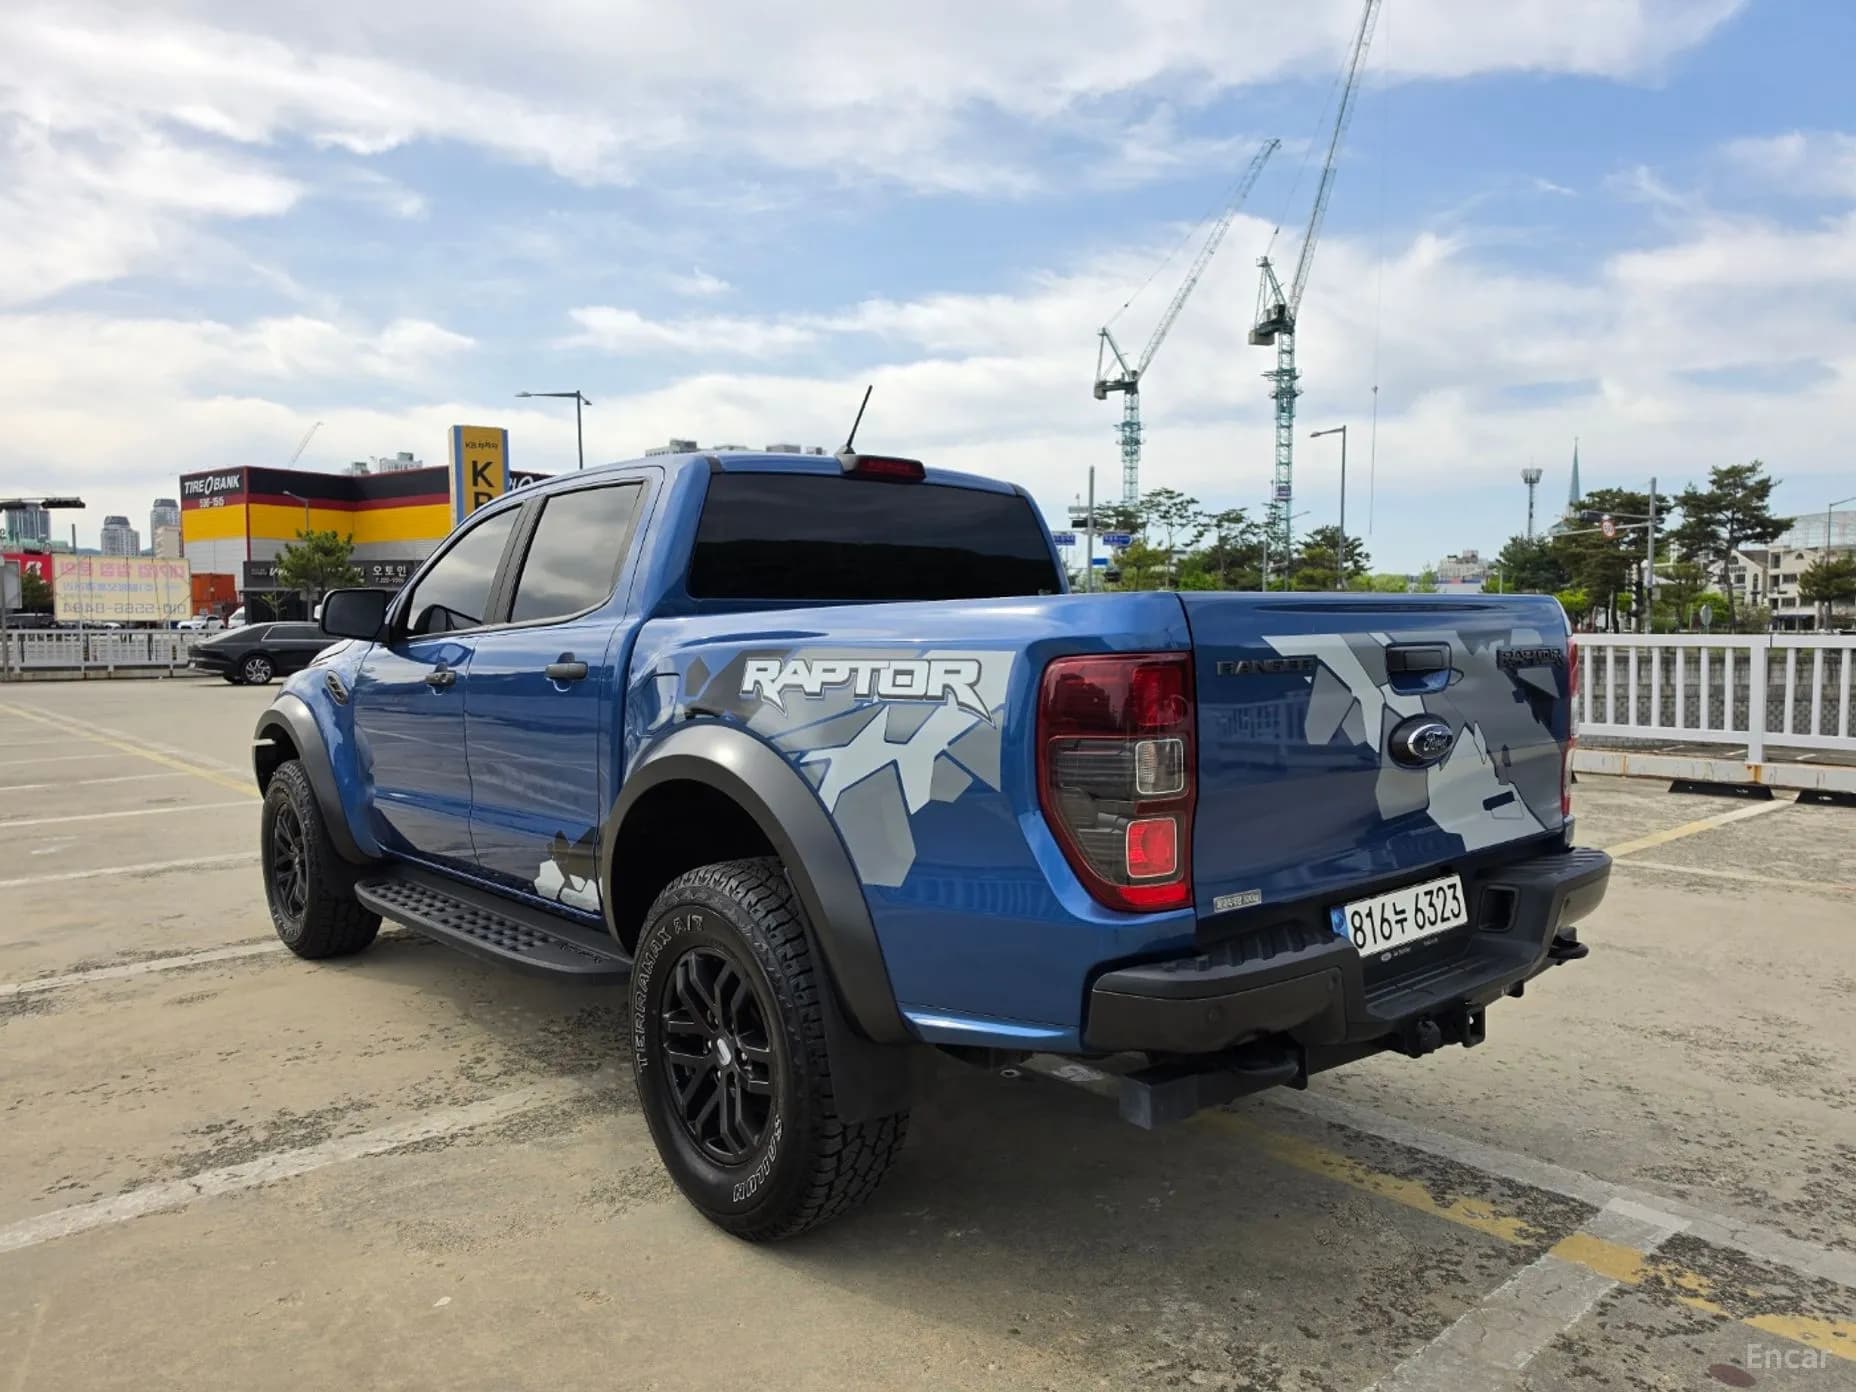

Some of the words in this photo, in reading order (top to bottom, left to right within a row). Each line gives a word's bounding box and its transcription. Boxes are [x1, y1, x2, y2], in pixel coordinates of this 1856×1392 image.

[740, 658, 996, 729] RAPTOR
[1423, 730, 1450, 752] Ford
[1351, 902, 1407, 949] 816누
[1414, 883, 1461, 930] 6323
[635, 926, 672, 1073] TERRAMAX
